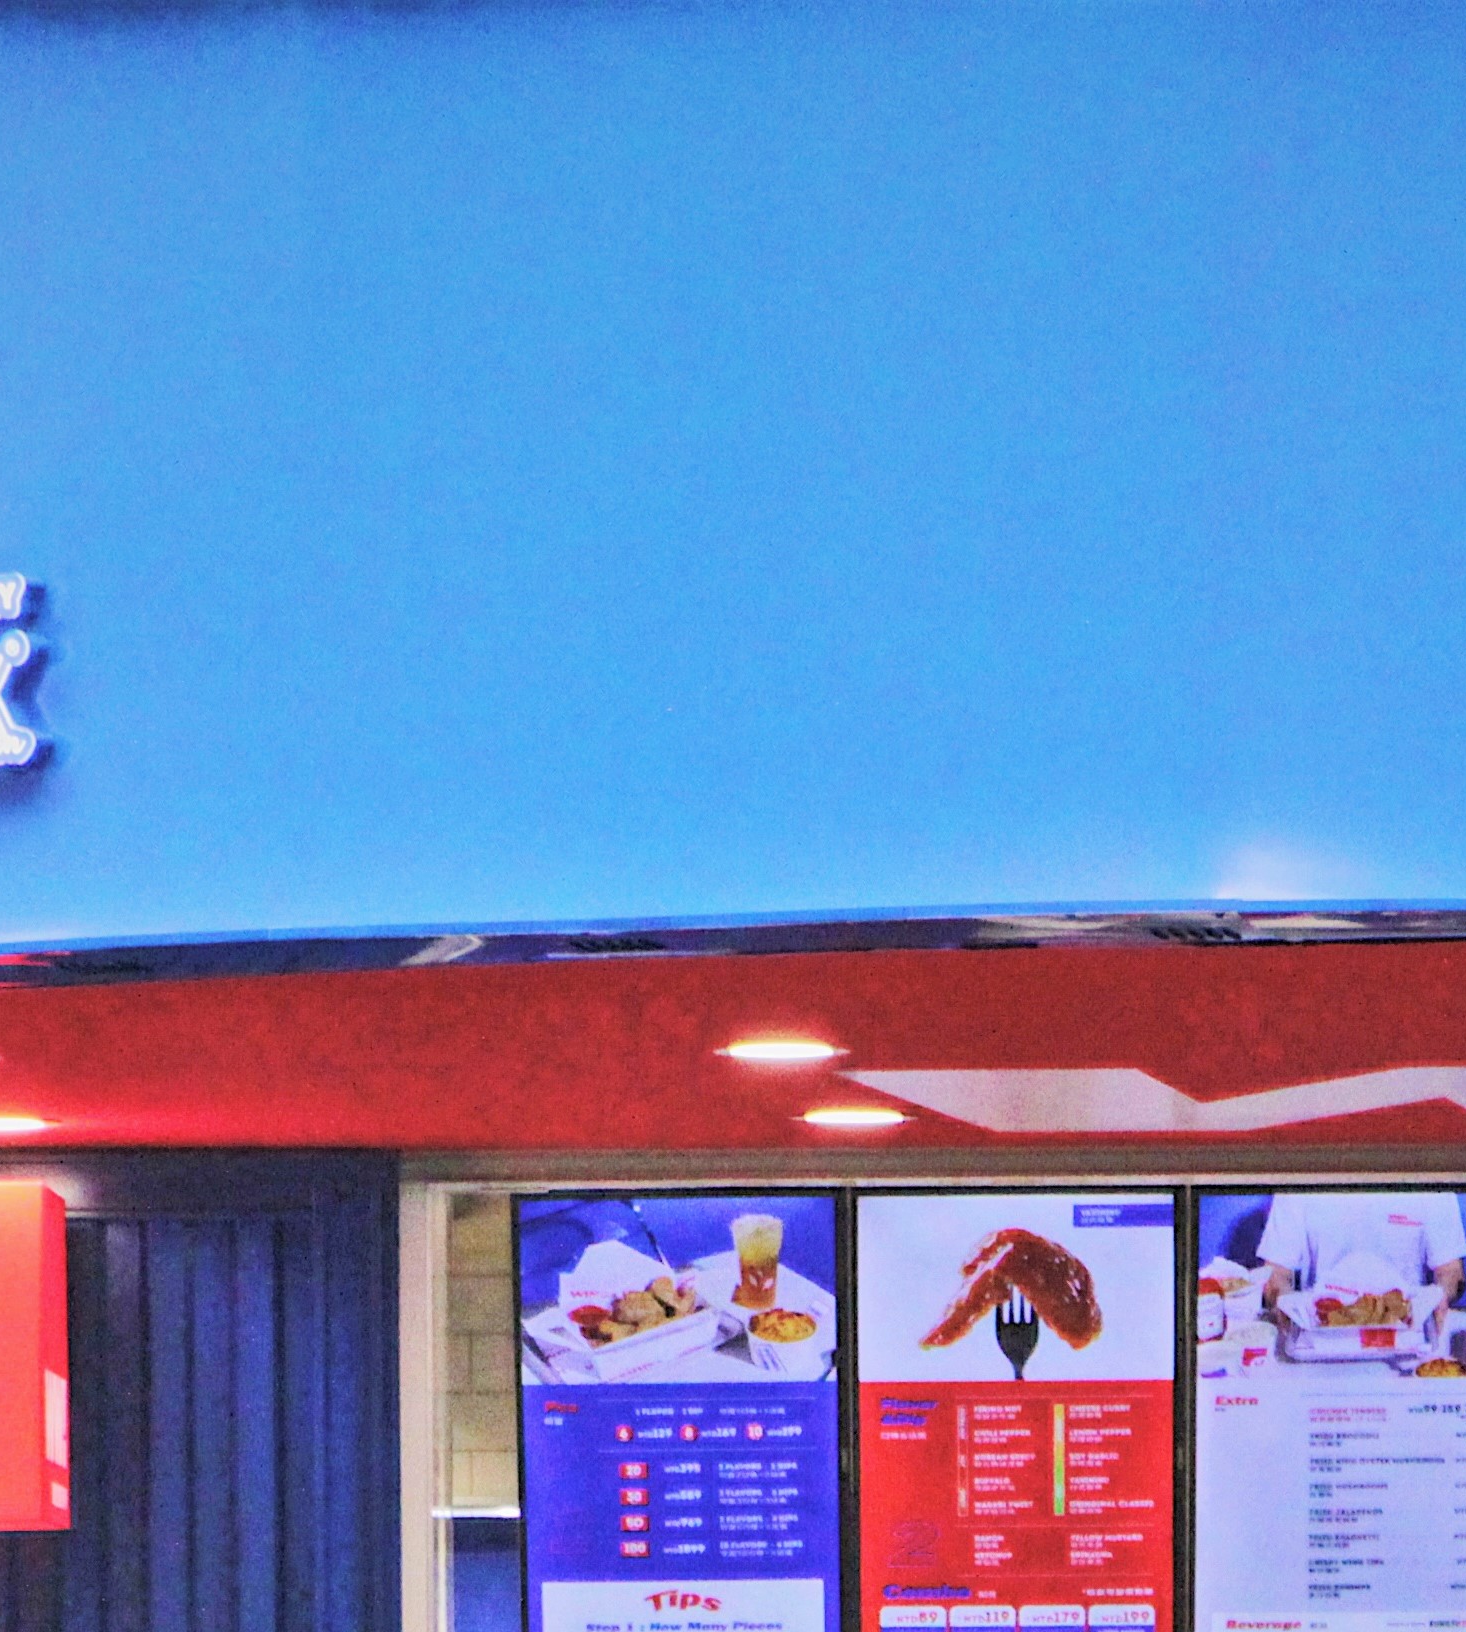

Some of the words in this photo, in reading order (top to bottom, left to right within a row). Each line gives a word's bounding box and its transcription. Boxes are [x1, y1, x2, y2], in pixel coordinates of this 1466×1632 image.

[1215, 1396, 1258, 1406] Extra
[645, 1590, 722, 1612] Tips
[586, 1623, 621, 1632] Step
[650, 1623, 681, 1631] How
[688, 1622, 727, 1632] Many
[733, 1622, 782, 1631] Pieces
[1226, 1619, 1301, 1631] Beverage
